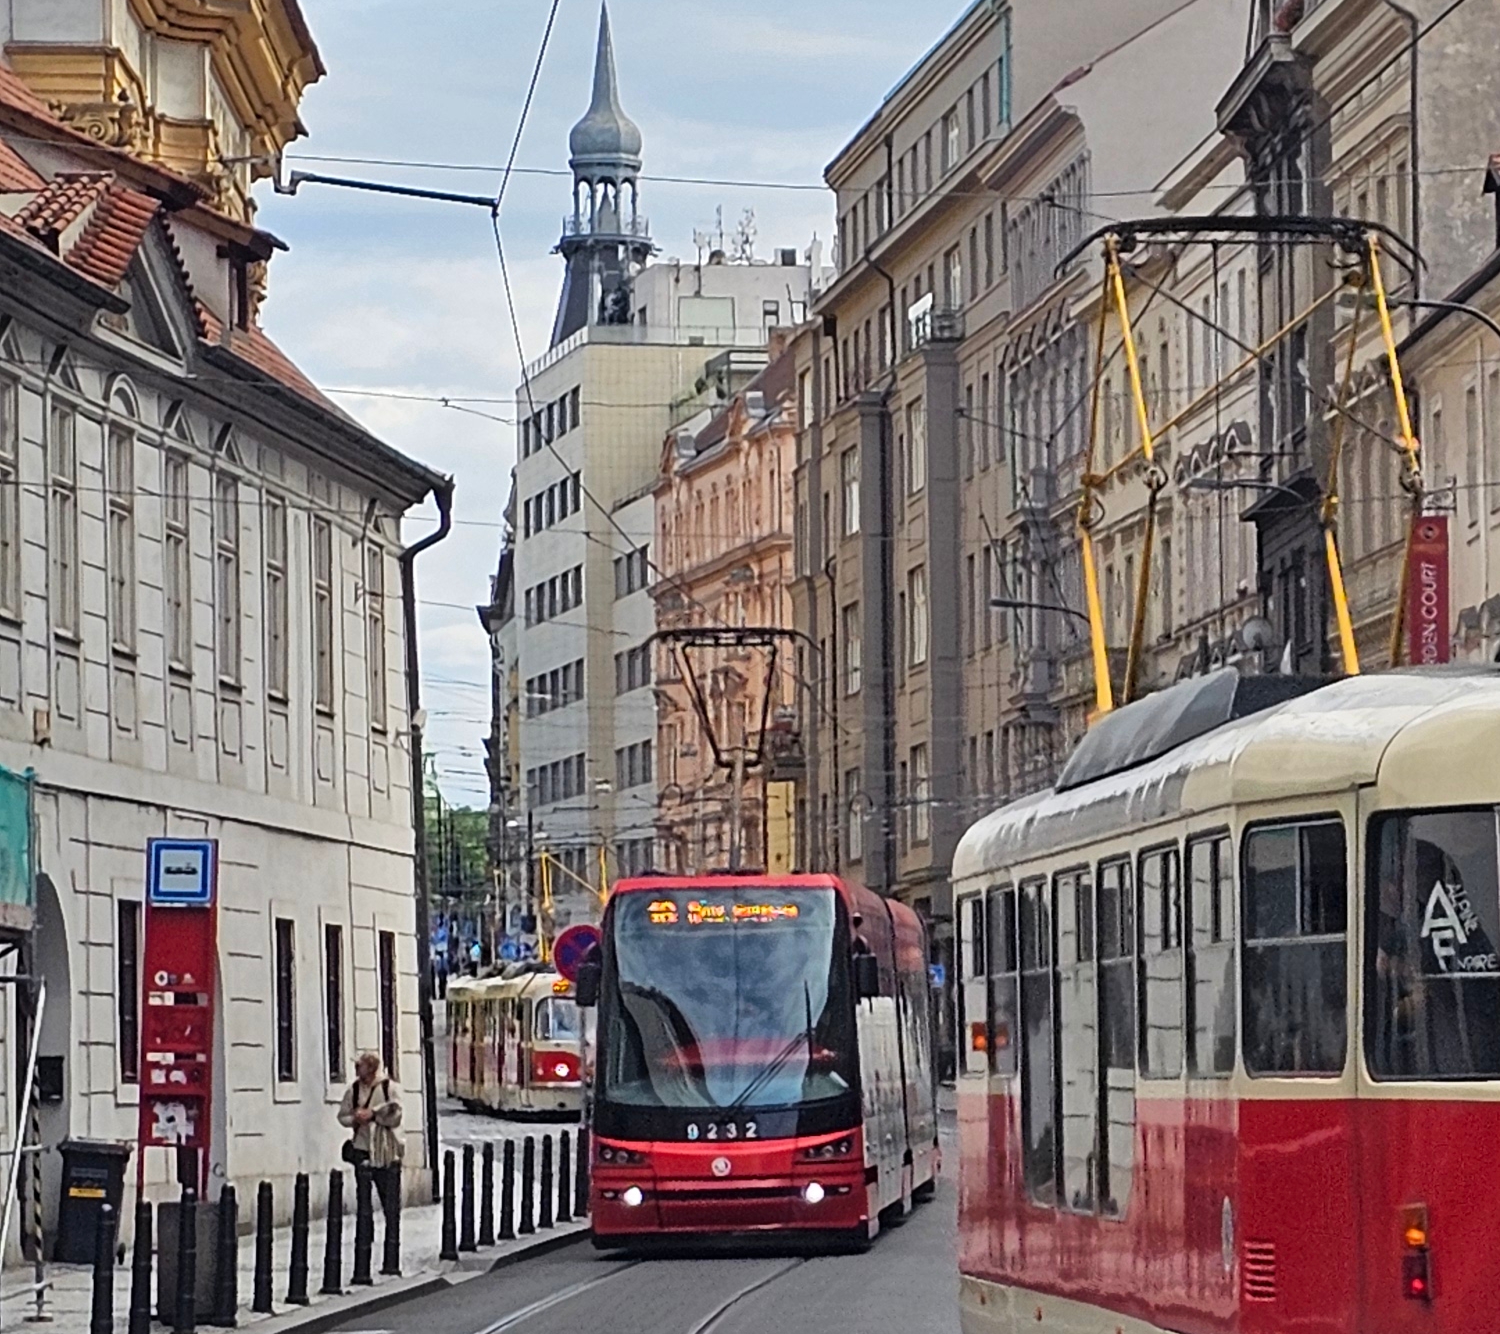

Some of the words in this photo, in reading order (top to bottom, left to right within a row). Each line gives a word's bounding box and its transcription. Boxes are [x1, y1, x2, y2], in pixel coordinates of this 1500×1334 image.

[1421, 562, 1437, 619] COURT
[1446, 883, 1478, 936] ALPINE
[687, 1122, 757, 1140] 9232
